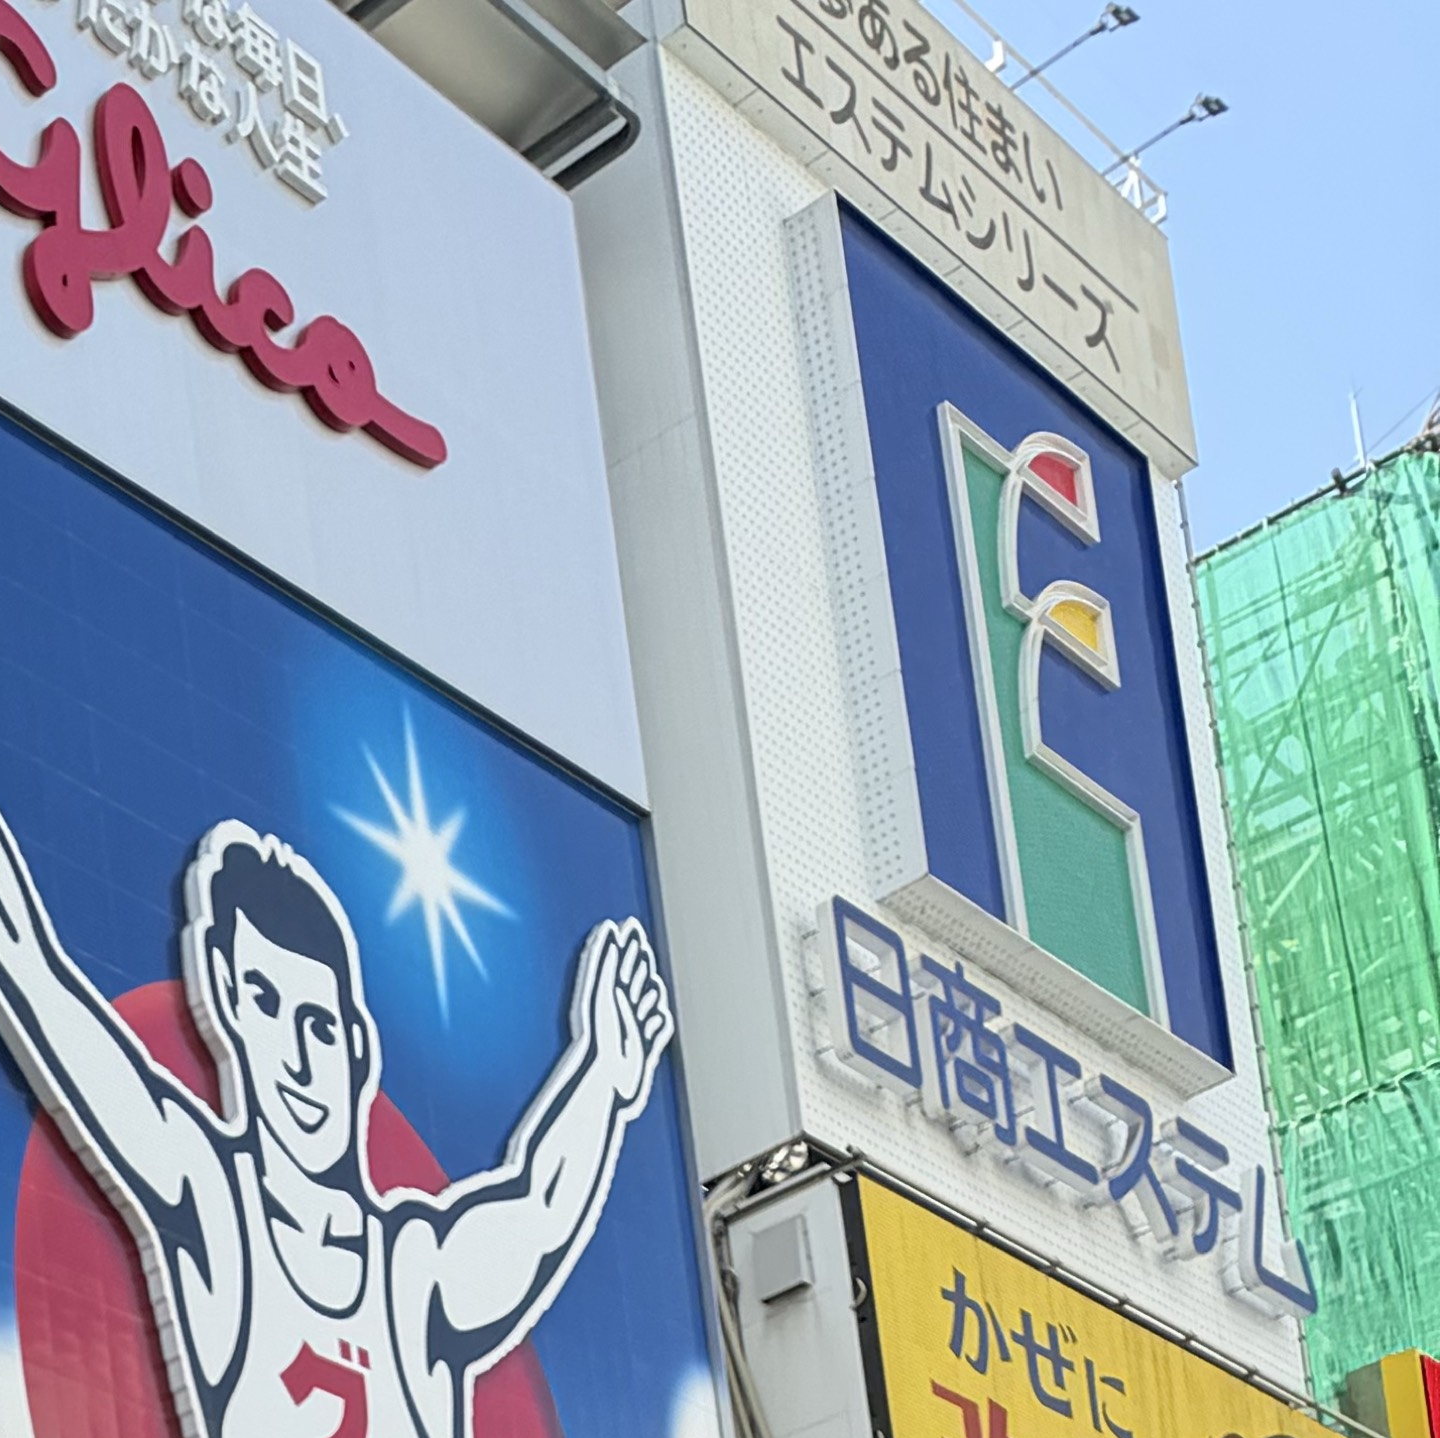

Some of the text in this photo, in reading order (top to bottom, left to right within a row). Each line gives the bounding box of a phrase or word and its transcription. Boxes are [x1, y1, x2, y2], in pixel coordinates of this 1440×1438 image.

[776, 14, 1121, 374] エステムシリーズ
[830, 893, 1318, 1316] 日商エステム
